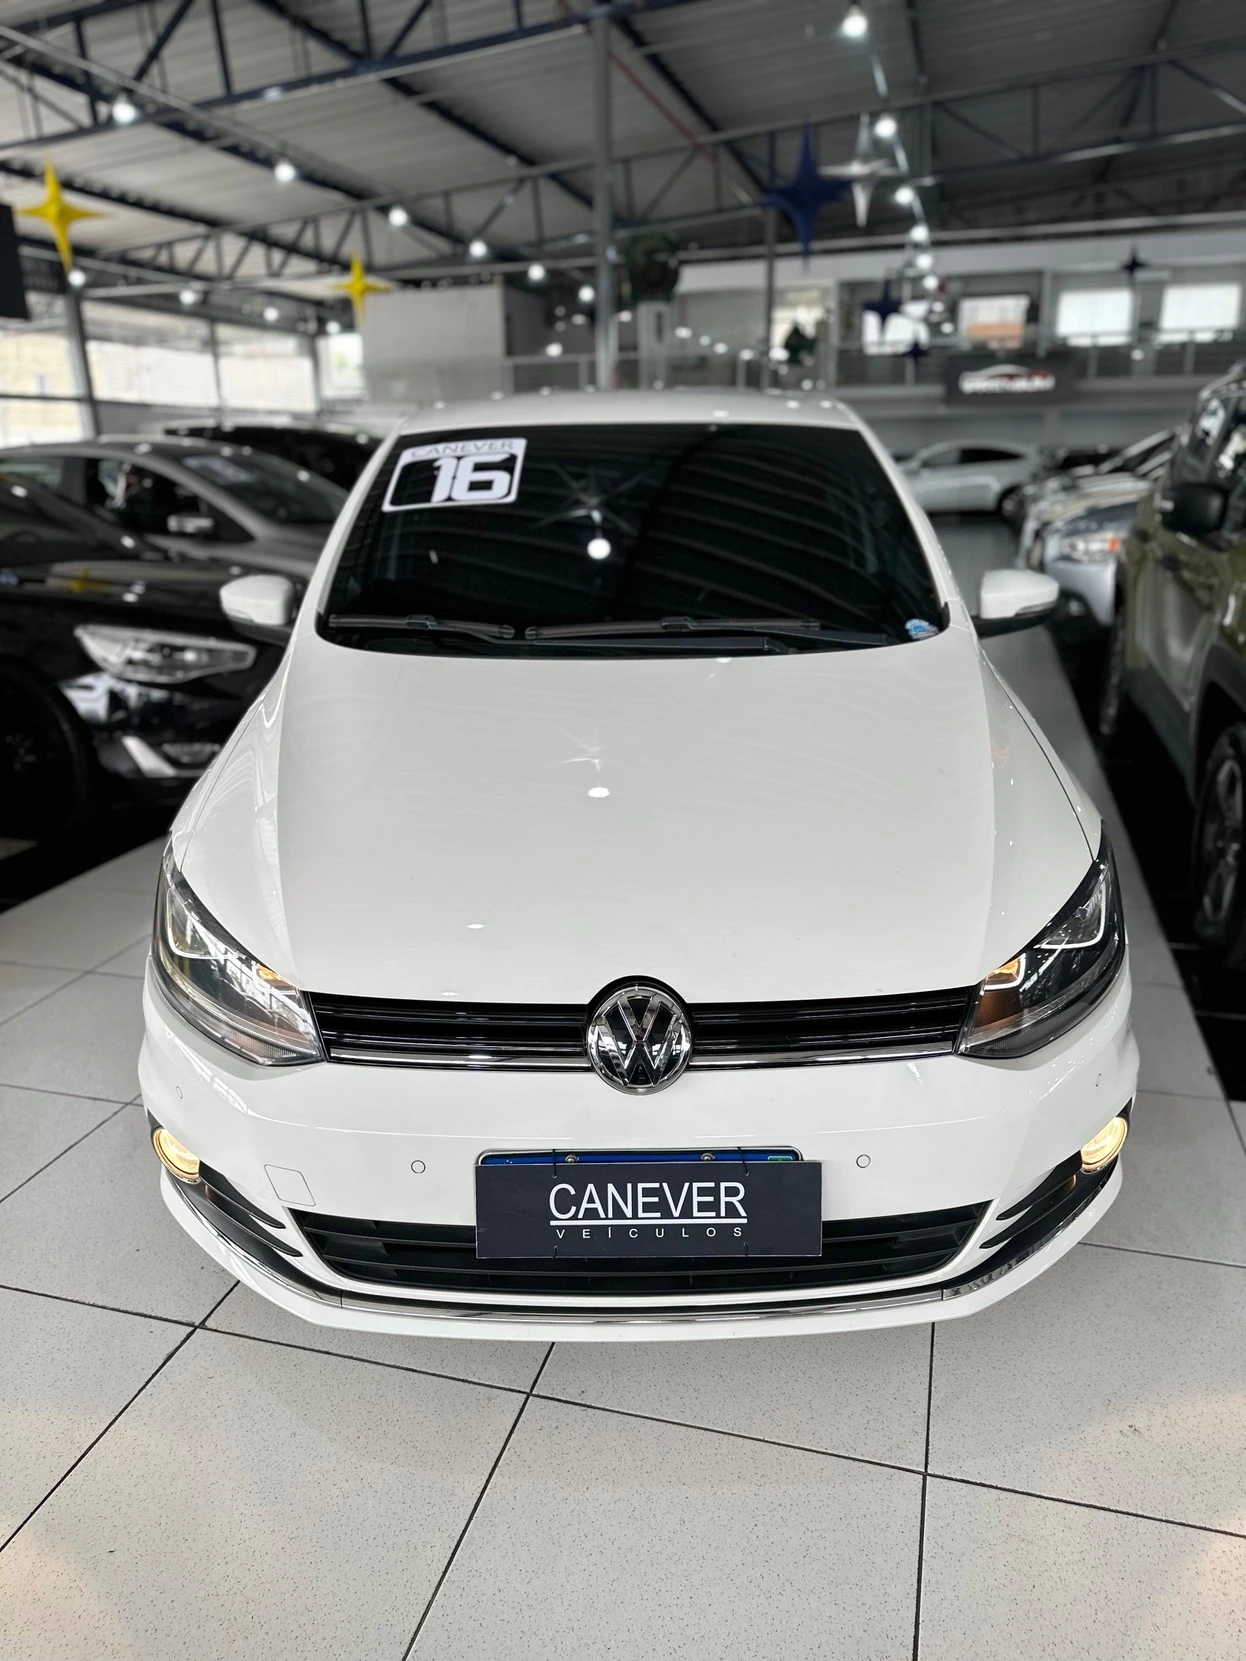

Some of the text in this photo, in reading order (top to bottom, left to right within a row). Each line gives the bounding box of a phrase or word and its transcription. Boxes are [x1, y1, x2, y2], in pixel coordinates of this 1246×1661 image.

[411, 440, 513, 458] CANEVER
[431, 452, 512, 503] 16
[549, 1182, 747, 1219] CANEVER
